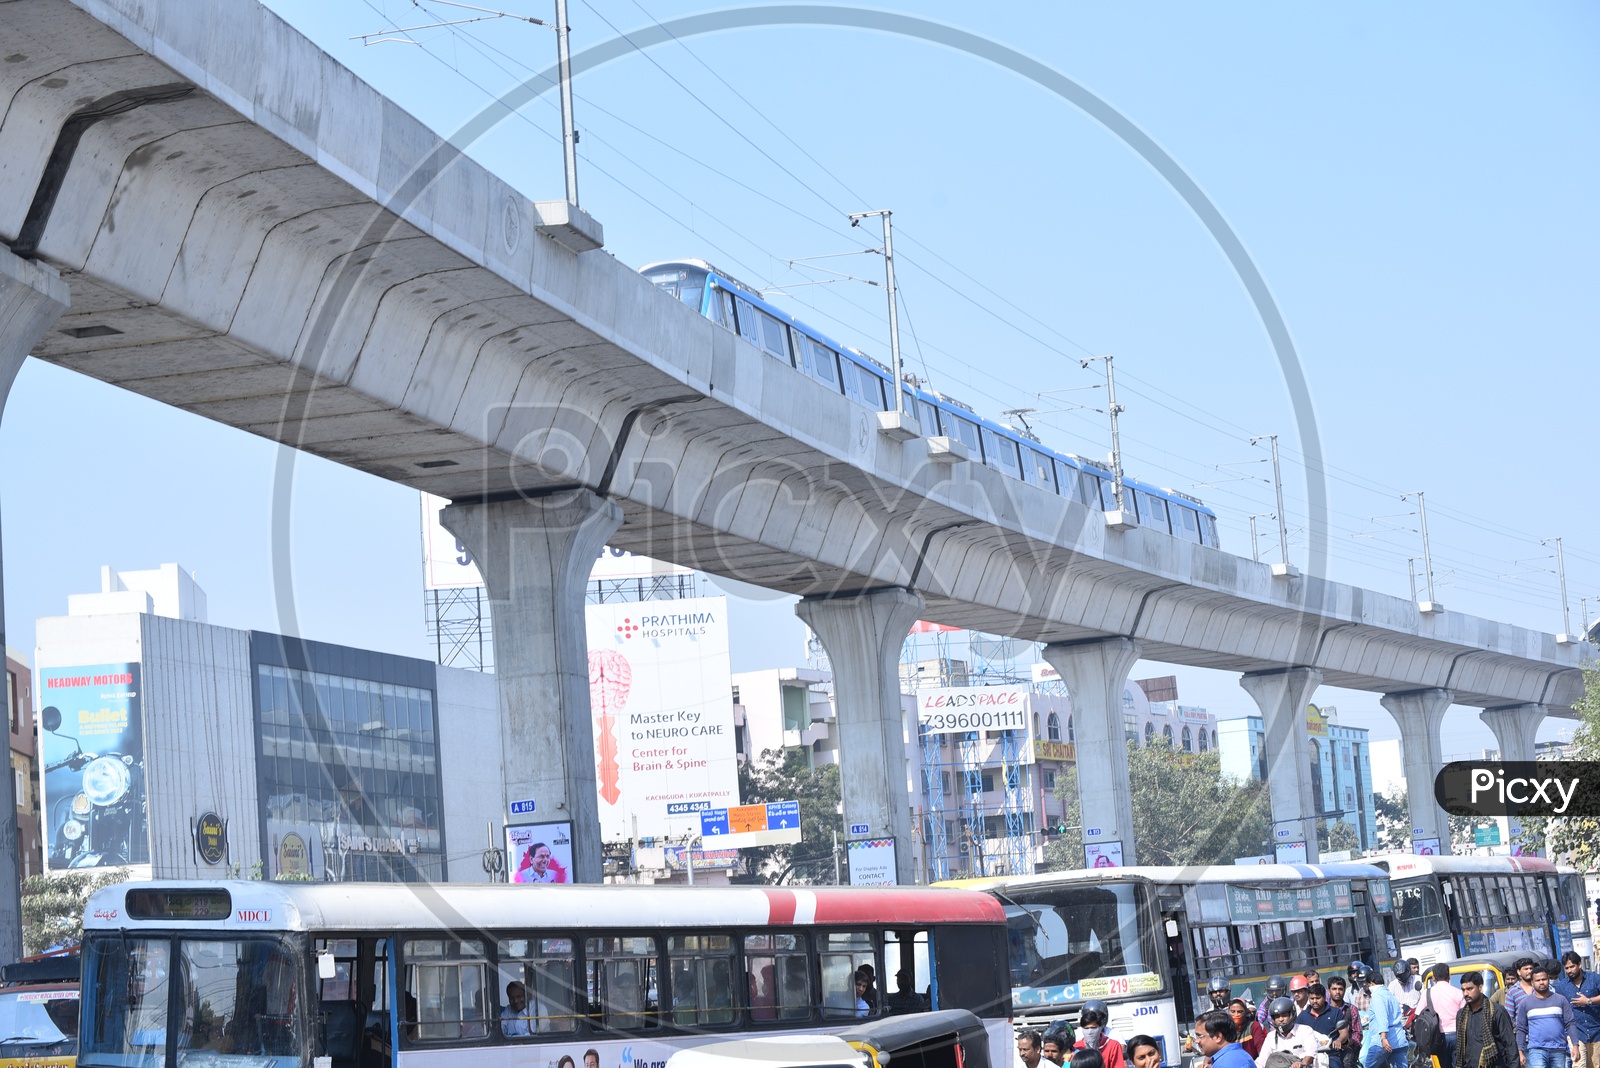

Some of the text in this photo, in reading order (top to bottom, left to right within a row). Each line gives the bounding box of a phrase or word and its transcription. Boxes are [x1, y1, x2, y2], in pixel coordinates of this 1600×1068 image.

[642, 612, 714, 627] PRATHIMA
[643, 627, 706, 638] HOSPITALS
[47, 673, 132, 688] HEADWAY MOTORS
[925, 692, 1018, 708] LEADSPACE
[78, 708, 127, 723] Bullet
[630, 711, 701, 724] Master Key
[923, 710, 1024, 729] 7396001111
[631, 725, 723, 740] to NEURO CARE
[632, 746, 687, 758] Center for
[633, 759, 706, 771] Brain & Spine
[514, 802, 532, 812] A 815
[670, 803, 708, 812] 4345 4345
[341, 834, 402, 852] SAINI'S DHABA
[1333, 884, 1348, 896] RMD
[1372, 884, 1385, 895] RMD
[195, 898, 208, 906] 219
[194, 907, 209, 916] 229
[238, 911, 271, 922] MDCL
[1110, 978, 1128, 994] 219
[1133, 1006, 1158, 1017] JDM
